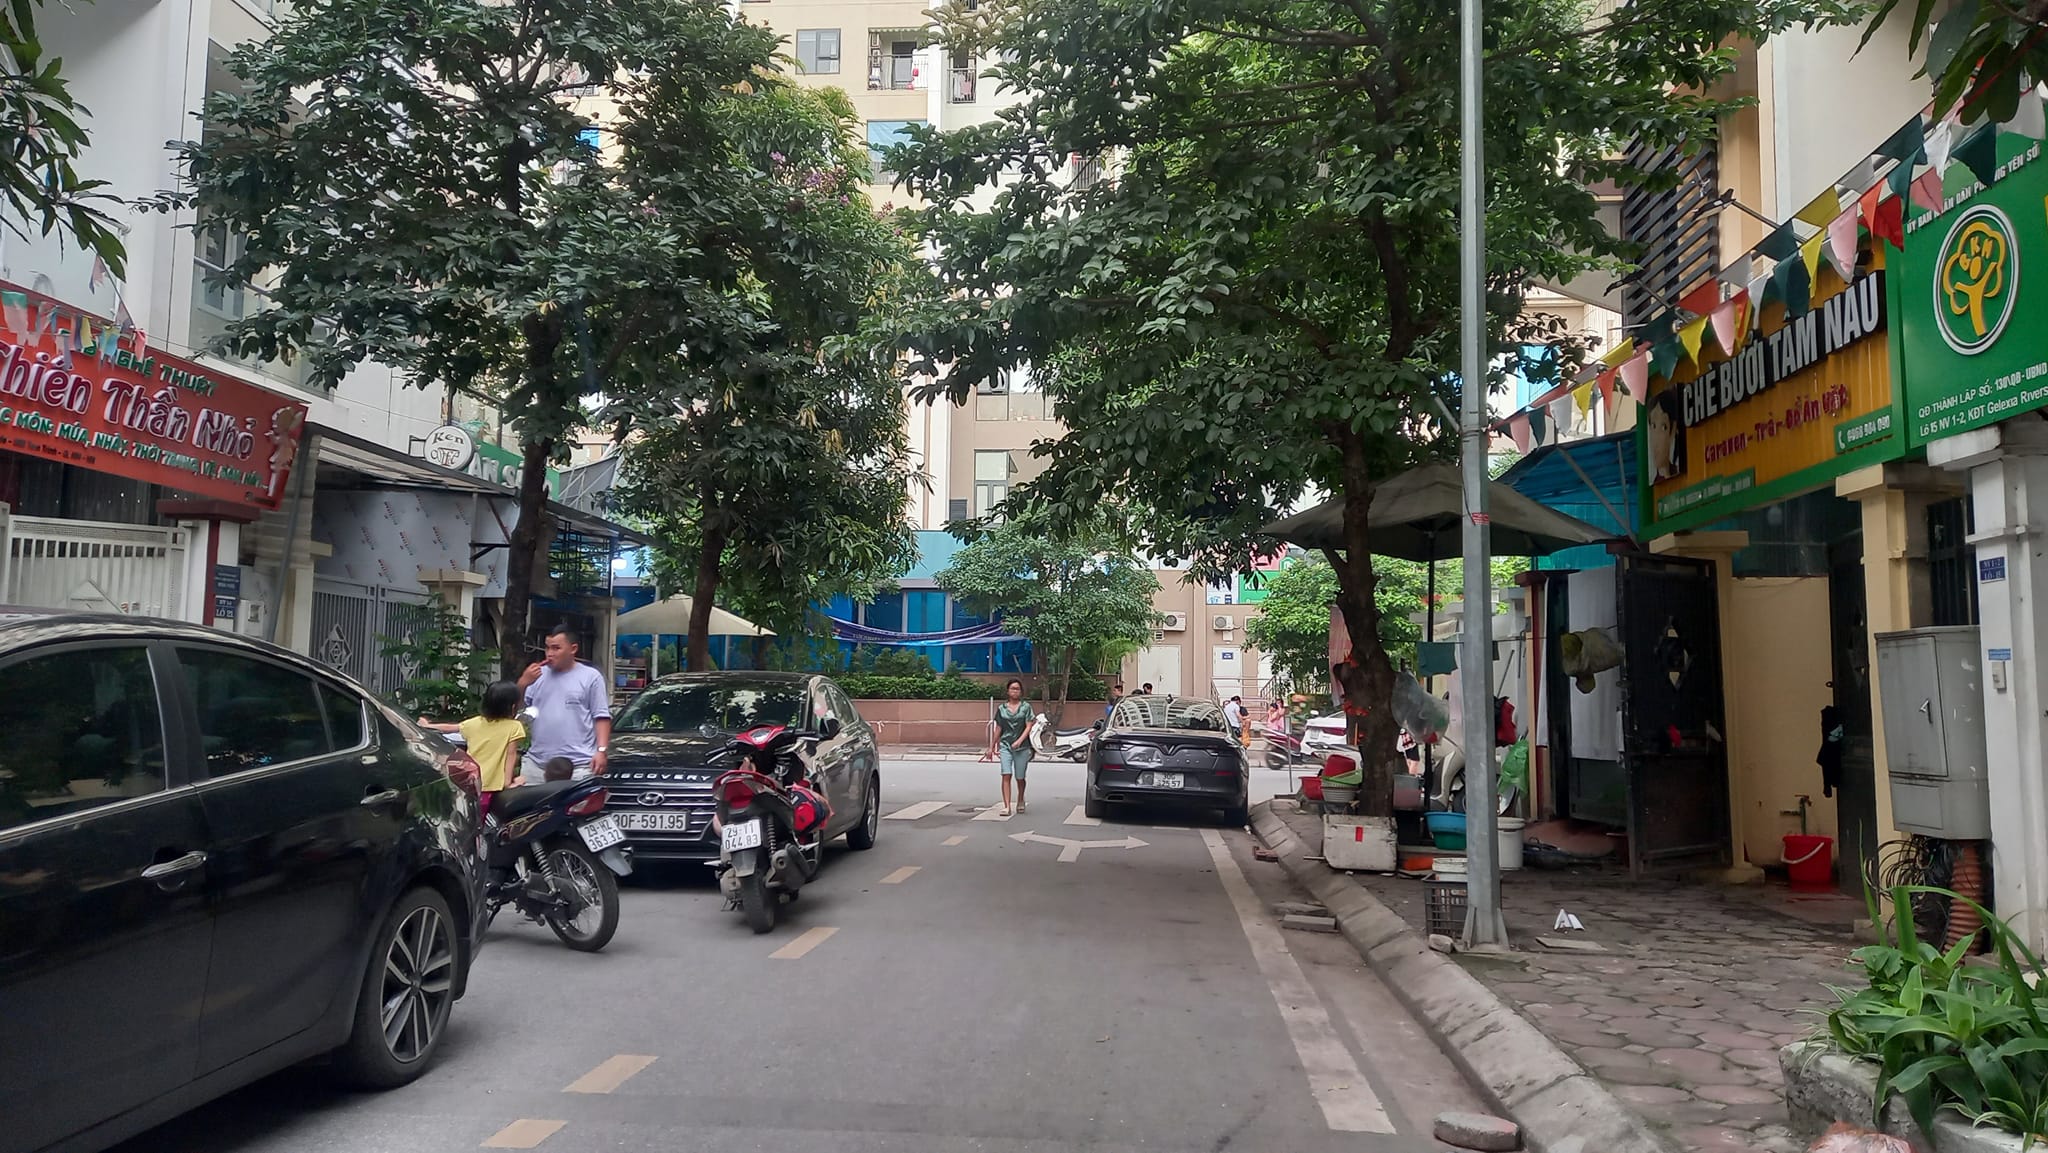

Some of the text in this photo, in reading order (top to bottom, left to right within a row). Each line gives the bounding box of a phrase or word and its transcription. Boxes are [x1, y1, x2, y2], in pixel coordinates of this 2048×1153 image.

[1683, 363, 1717, 427] CHÈ
[102, 378, 190, 442] Thần
[192, 407, 257, 460] Nhỏ
[602, 773, 711, 781] DISCOVERY
[613, 814, 684, 830] 30F-591.95
[589, 830, 622, 850] 363.32
[725, 833, 758, 850] 044.83
